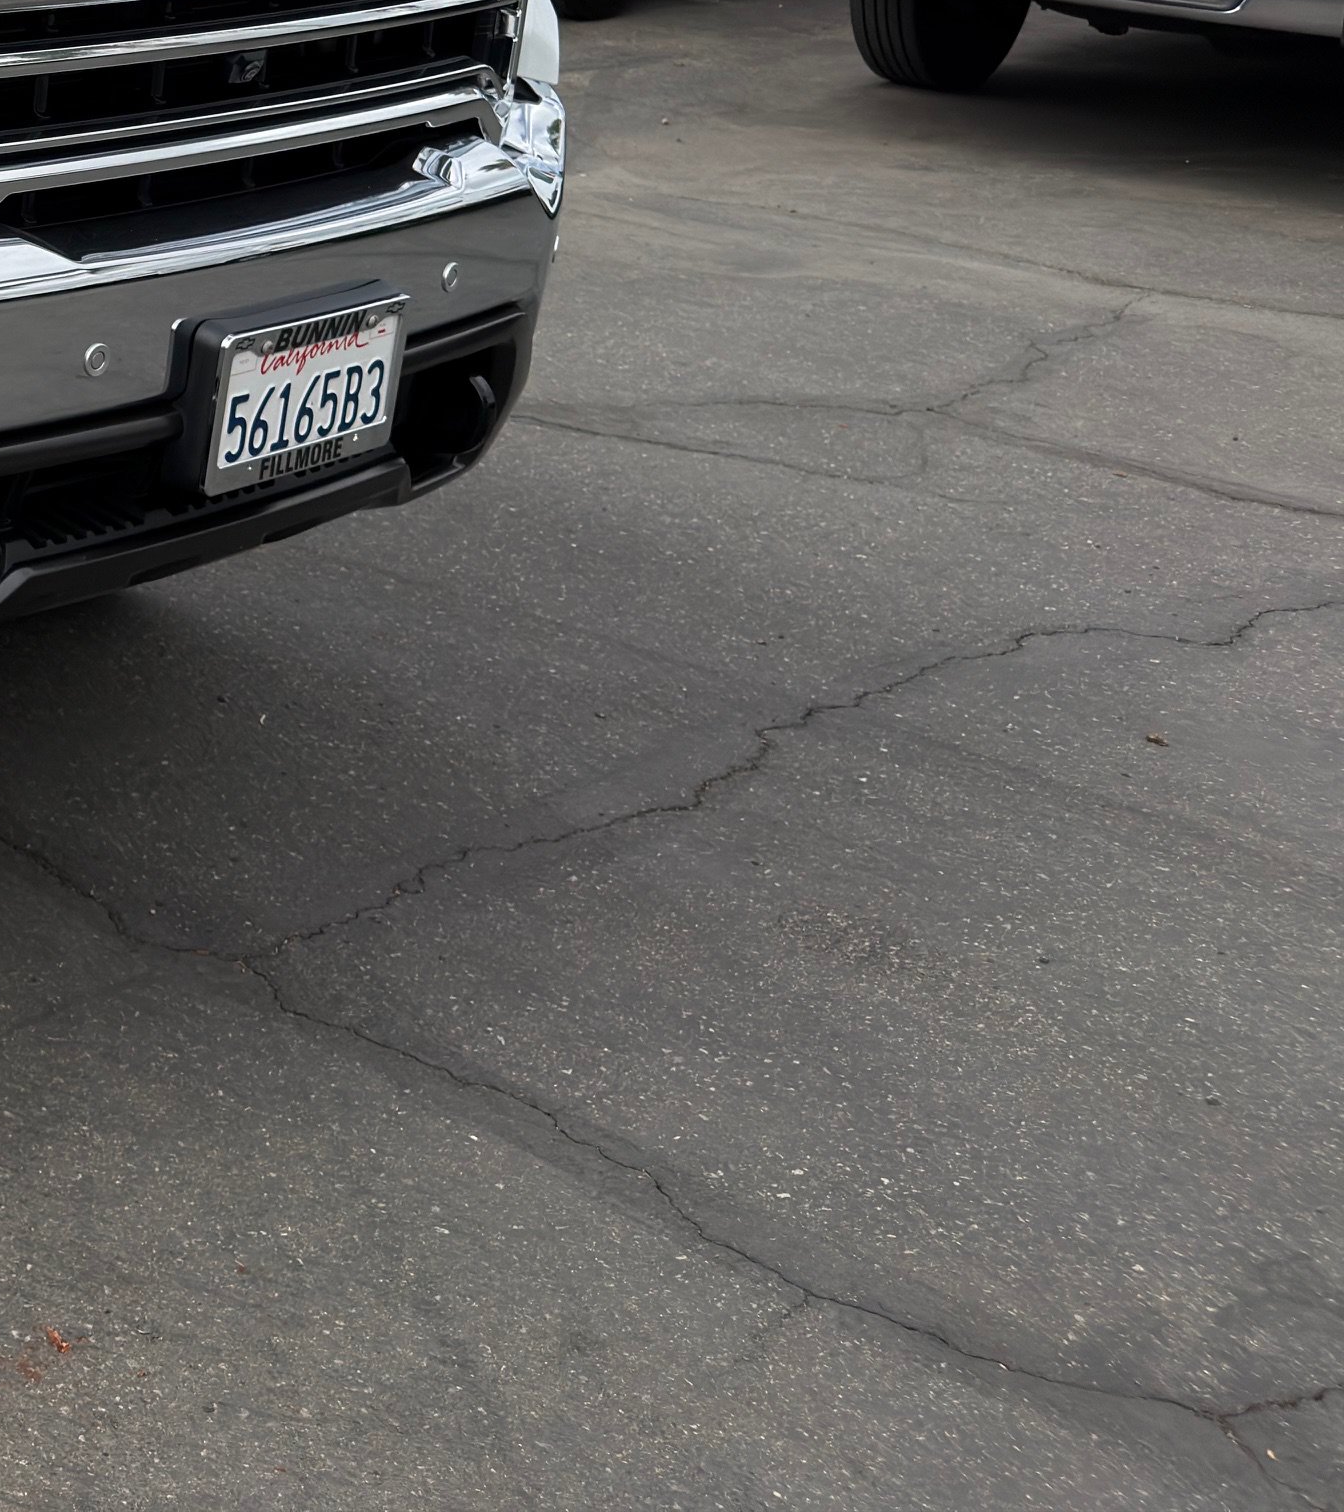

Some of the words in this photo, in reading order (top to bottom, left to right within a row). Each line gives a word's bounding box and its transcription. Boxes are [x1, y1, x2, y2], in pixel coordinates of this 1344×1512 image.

[260, 330, 370, 376] California
[273, 309, 368, 353] BUNNIN
[224, 358, 385, 463] 56165B3
[259, 437, 344, 480] FILLMORE
